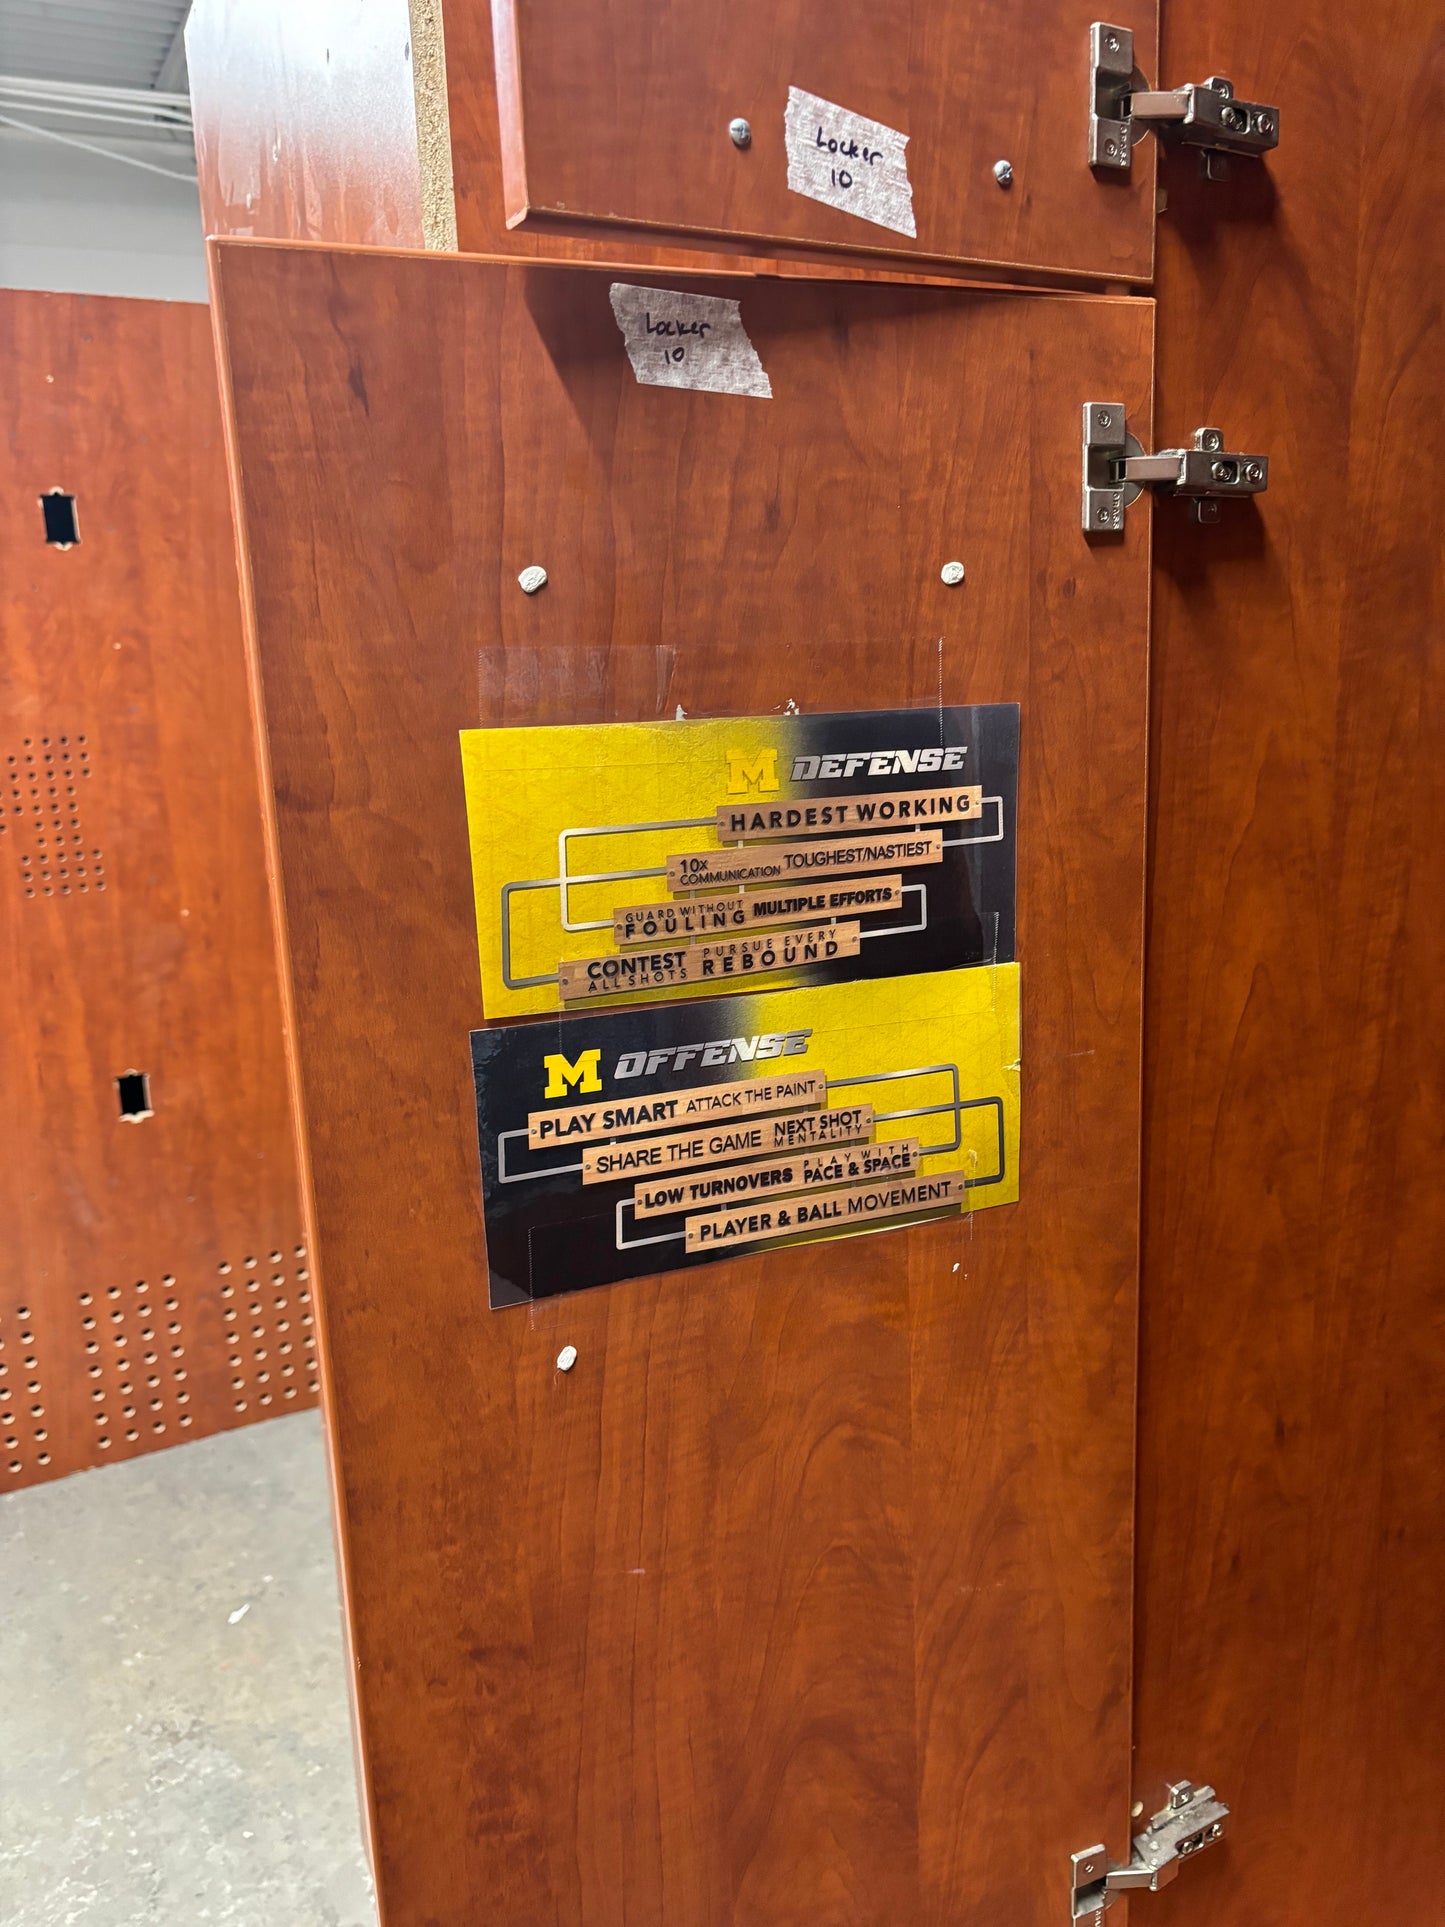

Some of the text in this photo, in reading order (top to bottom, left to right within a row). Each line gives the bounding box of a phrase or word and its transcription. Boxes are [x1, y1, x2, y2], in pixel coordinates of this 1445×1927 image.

[816, 127, 884, 166] Locker
[831, 168, 853, 189] 10
[645, 312, 711, 339] Locker
[664, 347, 685, 365] 10
[726, 746, 968, 794] M DEFENSE
[731, 794, 970, 832] HARDEST WORKING
[784, 841, 932, 869] TOUGHEST/NASTIEST
[680, 865, 780, 886] COMMUNICATION
[625, 900, 744, 923] GUARD WITHOUT
[753, 888, 892, 917] MULTIPLE EFFORTS
[625, 910, 745, 938] FOULING
[703, 929, 837, 957] PURSUE EVERY
[587, 951, 686, 980] CONTEST
[703, 941, 838, 976] REBOUND
[588, 968, 688, 992] ALL SHOTS
[544, 1029, 813, 1099] M OFFENSE
[540, 1080, 816, 1139] PLAY SMART ATTACK THE PAINT
[774, 1110, 862, 1136] NEXT SHOT
[774, 1124, 863, 1147] MENTALITY
[596, 1130, 762, 1173] SHARE THE GAME
[803, 1144, 909, 1168] PLAY WITH
[803, 1153, 911, 1184] PACE & SPACE
[645, 1168, 793, 1209] LOW TURNOVERS
[700, 1181, 951, 1241] PLAYER & BALL MOVEMENT
